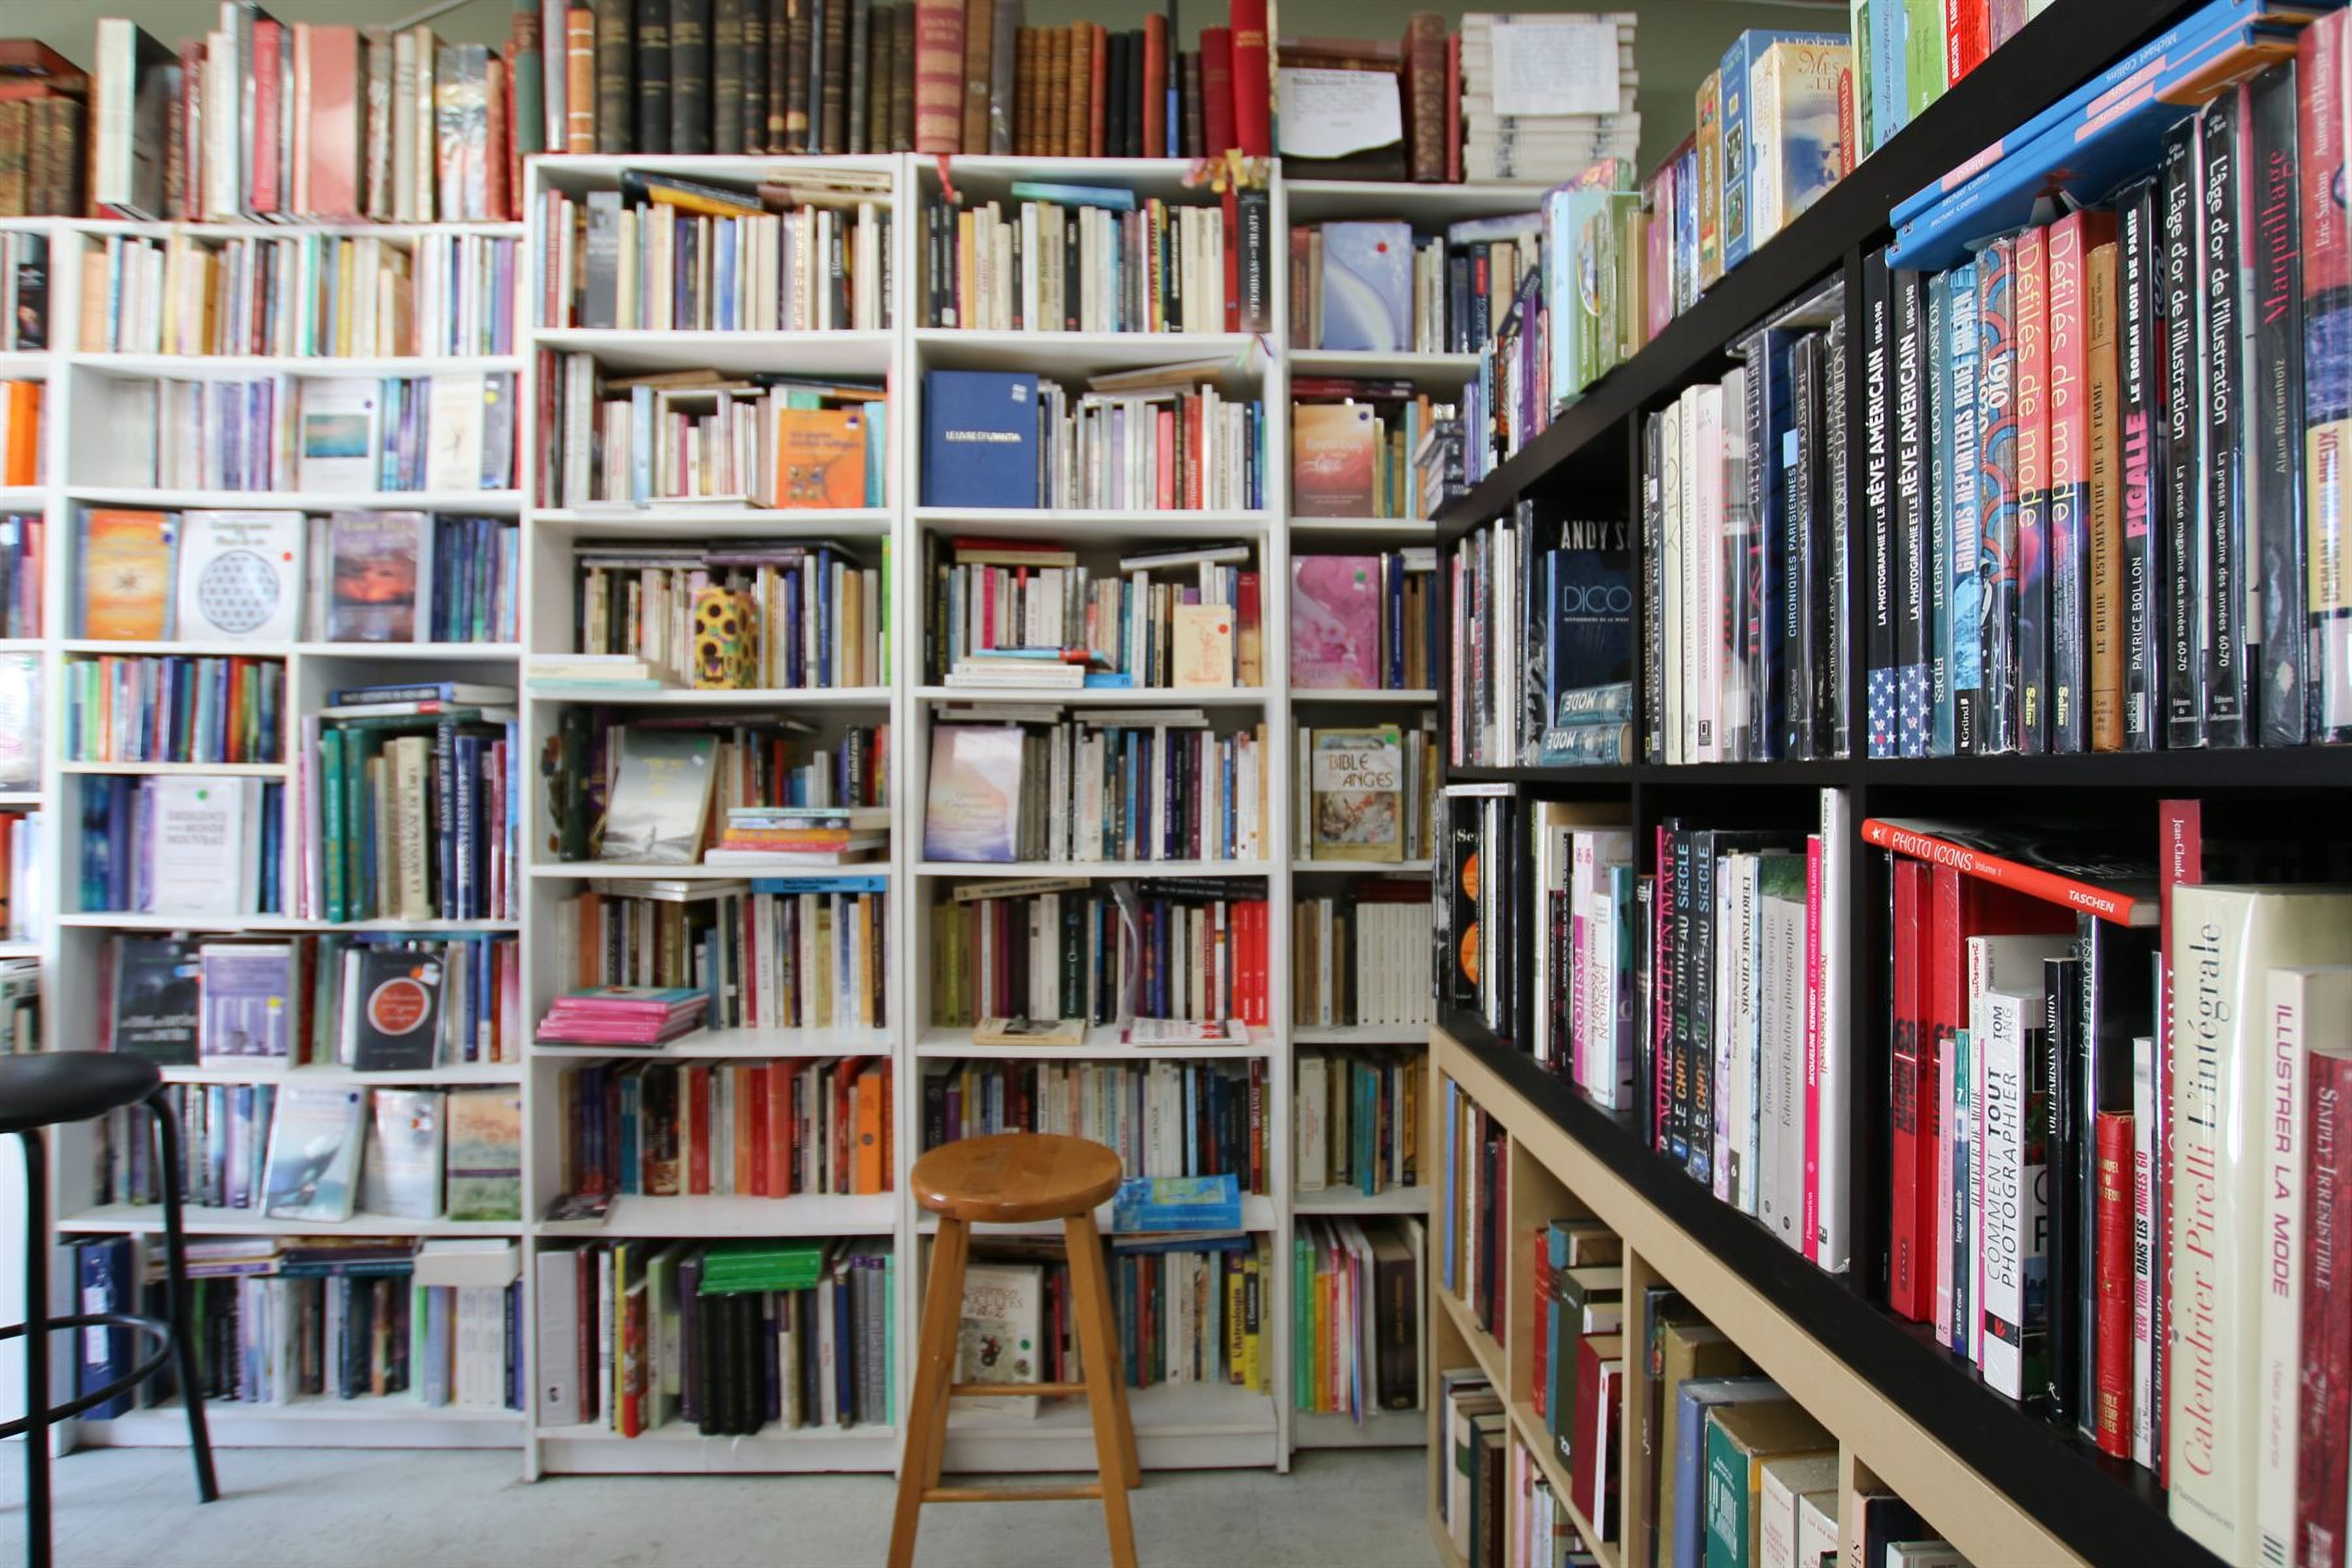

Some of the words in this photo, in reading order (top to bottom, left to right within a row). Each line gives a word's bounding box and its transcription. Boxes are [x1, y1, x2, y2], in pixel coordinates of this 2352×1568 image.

[2206, 155, 2227, 214] L'âge
[2127, 209, 2138, 255] PARIS
[2166, 182, 2187, 238] L'âge
[2211, 218, 2229, 261] d'or
[2261, 148, 2299, 324] Maquillage
[2128, 257, 2138, 280] DE
[2169, 242, 2186, 282] d'or
[2211, 267, 2229, 295] de
[2017, 242, 2040, 363] Défilés
[2049, 229, 2074, 353] Défilés
[2129, 282, 2140, 320] NOIR
[2170, 290, 2187, 315] de
[2129, 322, 2140, 380] ROMAN
[2212, 297, 2230, 425] l'illustration
[1865, 348, 1886, 454] AMÉRICAIN
[1897, 333, 1917, 443] AMÉRICAIN
[1988, 355, 2008, 408] 1910
[2018, 374, 2041, 416] de
[2051, 365, 2076, 408] de
[2130, 383, 2141, 403] LE
[2170, 318, 2188, 439] l'illustration
[2092, 381, 2102, 427] FEMME
[1953, 409, 1975, 504] REPORTERS
[2093, 435, 2103, 451] LA
[1867, 457, 1886, 506] RÊVE
[1897, 445, 1918, 497] RÊVE
[2019, 429, 2042, 527] mode
[2051, 421, 2077, 521] mode
[2093, 459, 2104, 474] DE
[2125, 409, 2148, 538] PIGALLE
[2217, 470, 2227, 506] presse
[1787, 468, 1797, 551] PARISIENNES
[1877, 506, 1886, 519] LE
[1908, 497, 1918, 511] LE
[1908, 513, 1918, 525] ET
[1932, 480, 1943, 546] MONDE
[2175, 482, 2184, 518] presse
[1561, 520, 1608, 550] ANDY
[1877, 521, 1886, 534] ET
[1955, 506, 1975, 573] GRANDS
[2094, 481, 2105, 586] VESTIMENTAIRE
[2175, 522, 2185, 572] magazine
[2216, 510, 2227, 563] magazine
[1877, 534, 1887, 610] PHOTOGRAPHIE
[1908, 526, 1919, 607] PHOTOGRAPHIE
[2131, 556, 2142, 610] BOLLON
[2177, 576, 2186, 595] des
[2219, 567, 2228, 587] des
[1564, 585, 1631, 612] DICO
[1788, 555, 1797, 637] CHRONIQUES
[1878, 612, 1887, 626] LA
[1910, 608, 1919, 620] LA
[2095, 593, 2105, 632] GUIDE
[2177, 599, 2187, 637] années
[2219, 591, 2229, 631] années
[2095, 641, 2106, 654] LE
[2132, 614, 2143, 670] PATRICE
[2177, 641, 2187, 672] 60-70
[2219, 635, 2229, 667] 60-70
[1935, 657, 1944, 703] FIDES
[1961, 705, 1970, 740] Gründ
[1329, 753, 1369, 772] BIBLE
[1342, 772, 1393, 789] ANGES
[1892, 832, 1932, 858] PHOTO
[1934, 844, 1974, 872] ICONS
[2172, 818, 2185, 878] Jean-Claude
[2069, 889, 2115, 913] TASCHEN
[1575, 947, 1584, 1043] FASHION
[2047, 993, 2055, 1042] FASHION
[1676, 1013, 1688, 1041] DU
[1992, 1006, 2002, 1040] TOM
[2003, 1009, 2013, 1043] ANG
[2187, 923, 2230, 1130] L'intégrale
[1808, 1033, 1817, 1086] JACQUELINE
[2275, 1004, 2293, 1154] ILLUSTRER
[1987, 1068, 2001, 1137] TOUT
[2319, 1086, 2339, 1158] SIMPLY
[2002, 1073, 2017, 1288] PHOTOGRAPHIER
[2134, 1151, 2148, 1169] 60
[2274, 1166, 2291, 1200] LA
[1987, 1150, 2001, 1281] COMMENT
[2185, 1141, 2215, 1260] Pirelli
[2135, 1218, 2148, 1240] LES
[2135, 1241, 2148, 1276] DANS
[2273, 1213, 2291, 1299] MODE
[2135, 1277, 2148, 1309] YORK
[2135, 1313, 2148, 1343] NEW
[2183, 1270, 2215, 1476] Calendrier
